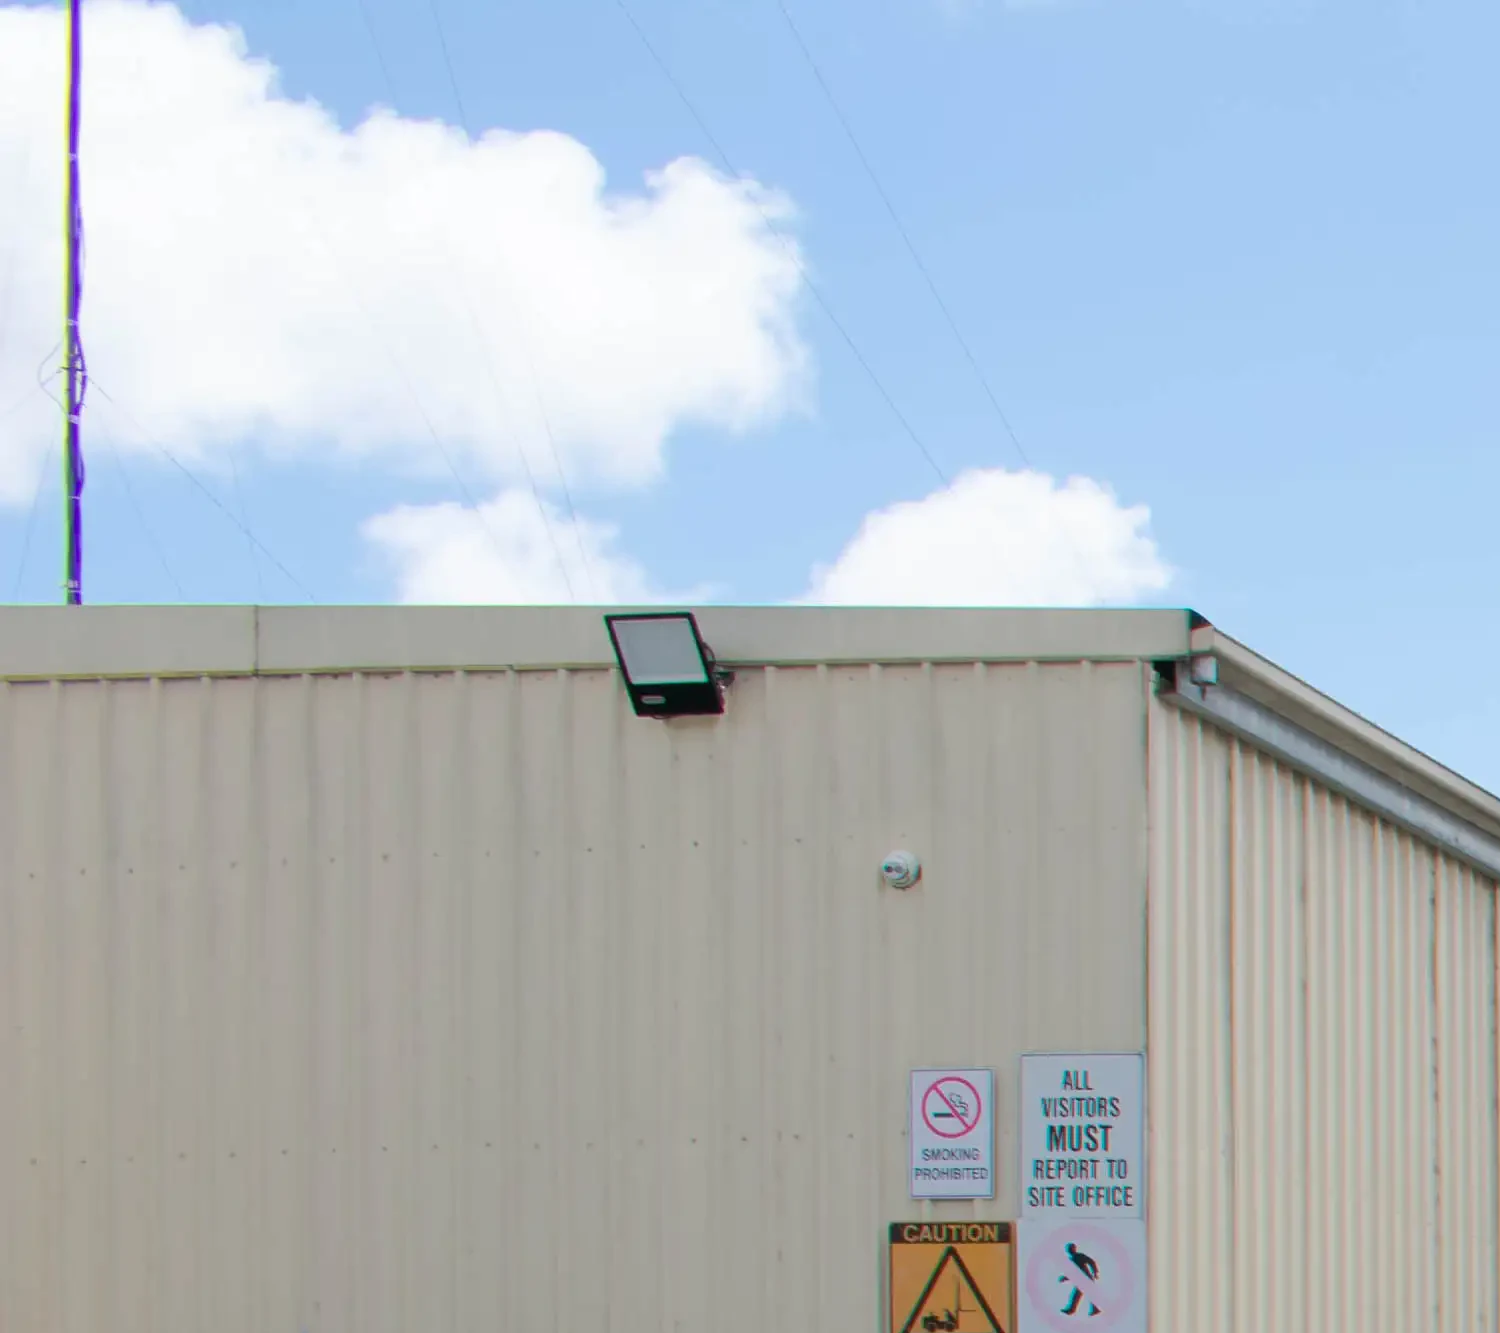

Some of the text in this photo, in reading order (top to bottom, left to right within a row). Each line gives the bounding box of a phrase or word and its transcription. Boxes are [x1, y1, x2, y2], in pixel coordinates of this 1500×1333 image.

[1062, 1070, 1093, 1090] ALL
[1042, 1097, 1121, 1117] VISITORS
[1047, 1125, 1113, 1152] MUST
[921, 1148, 980, 1161] SMOKING
[914, 1167, 988, 1181] PROHIBITED
[1033, 1159, 1128, 1180] REPORT TO
[1028, 1186, 1133, 1207] SITE OFFICE
[903, 1224, 1000, 1243] CAUTION
